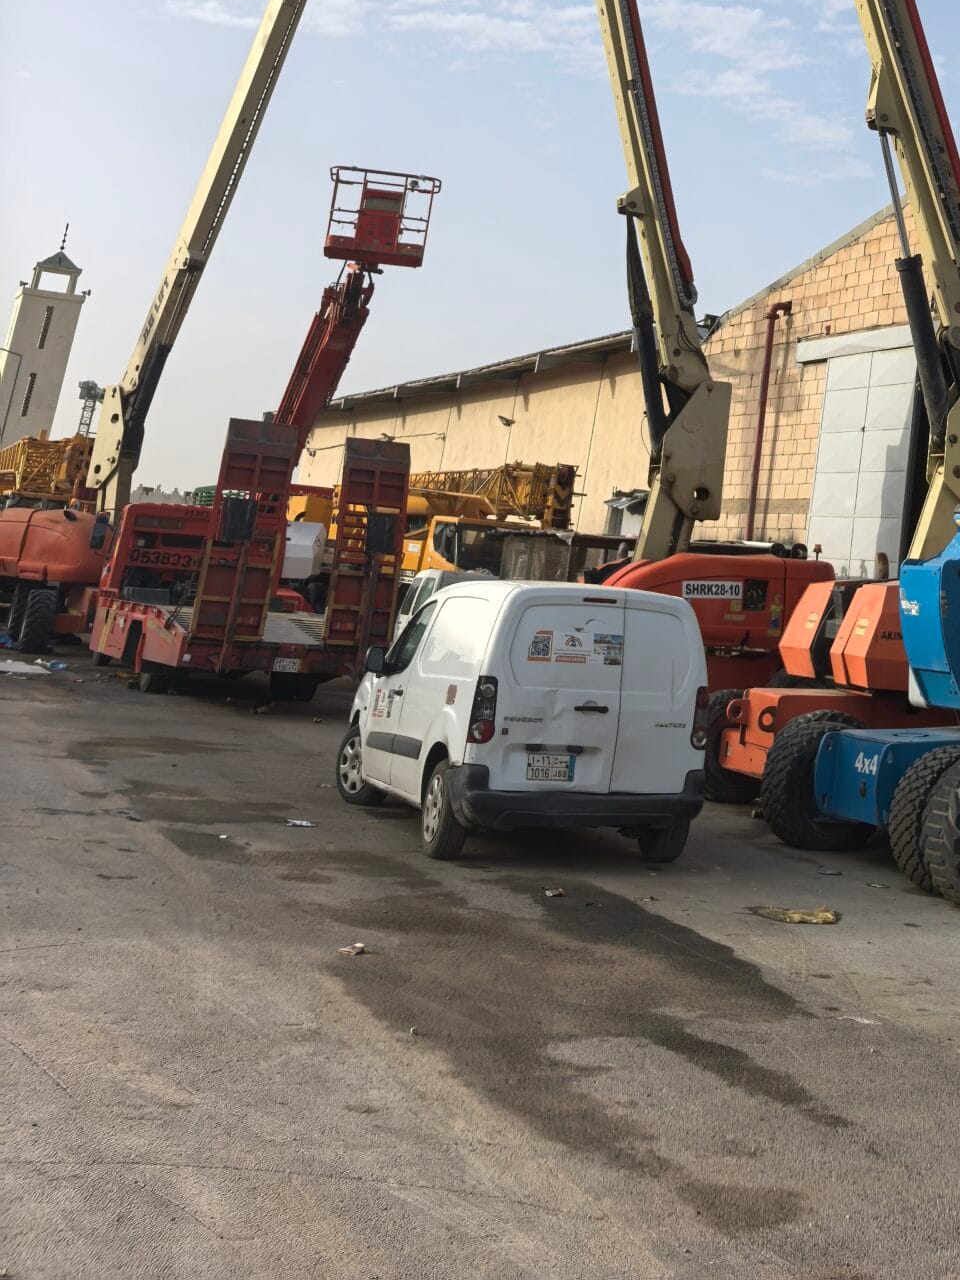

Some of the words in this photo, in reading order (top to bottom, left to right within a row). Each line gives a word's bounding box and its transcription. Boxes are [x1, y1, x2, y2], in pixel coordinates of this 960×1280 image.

[685, 583, 740, 596] SHRK28-10
[855, 751, 879, 776] 4x4
[530, 767, 550, 779] 1016
